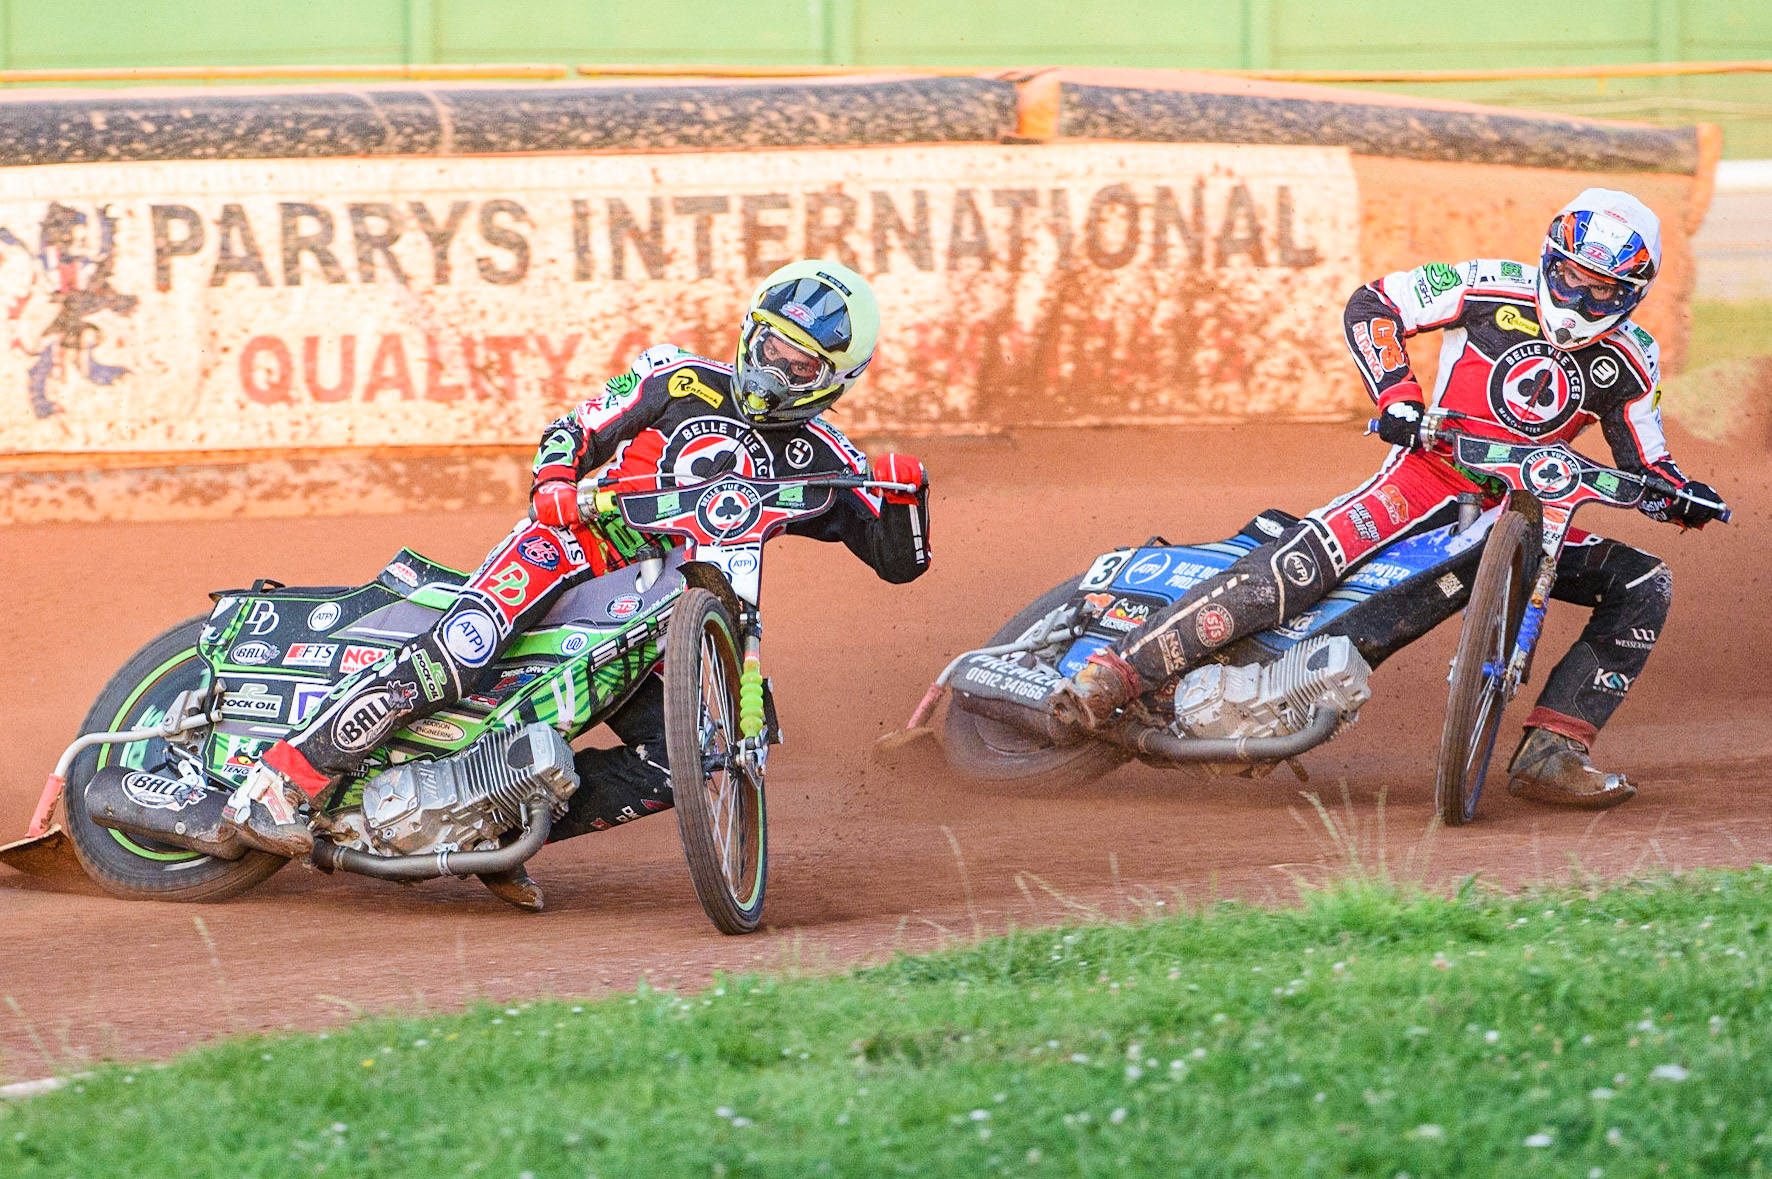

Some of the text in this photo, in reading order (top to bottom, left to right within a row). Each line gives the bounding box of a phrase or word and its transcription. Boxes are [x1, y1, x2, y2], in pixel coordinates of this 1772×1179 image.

[149, 184, 1320, 292] PARRYS INTERNATIONAL
[239, 333, 582, 405] QUALITY
[1506, 345, 1541, 366] BELLE
[1567, 370, 1580, 400] ACES
[681, 423, 768, 479] BELLE VUE AC
[1528, 451, 1547, 465] BELLE
[1551, 451, 1566, 459] VUE
[700, 486, 720, 507] BELLE
[741, 487, 758, 503] ACES
[733, 560, 752, 568] ATPI
[1090, 556, 1122, 585] 3
[1133, 563, 1161, 574] ATPI
[1172, 562, 1204, 577] BLUE
[1290, 554, 1307, 582] ATPI
[313, 611, 334, 621] ATPI
[612, 602, 636, 611] STS
[457, 620, 485, 653] ATPI
[1206, 615, 1225, 638] STS
[301, 645, 333, 659] FTS
[1166, 632, 1187, 671] NGK
[415, 653, 439, 699] ROCK OIL
[966, 667, 1048, 700] 01912 341666
[255, 701, 277, 711] OIL
[416, 726, 454, 740] ENGINEERING
[423, 720, 450, 730] ADDISON
